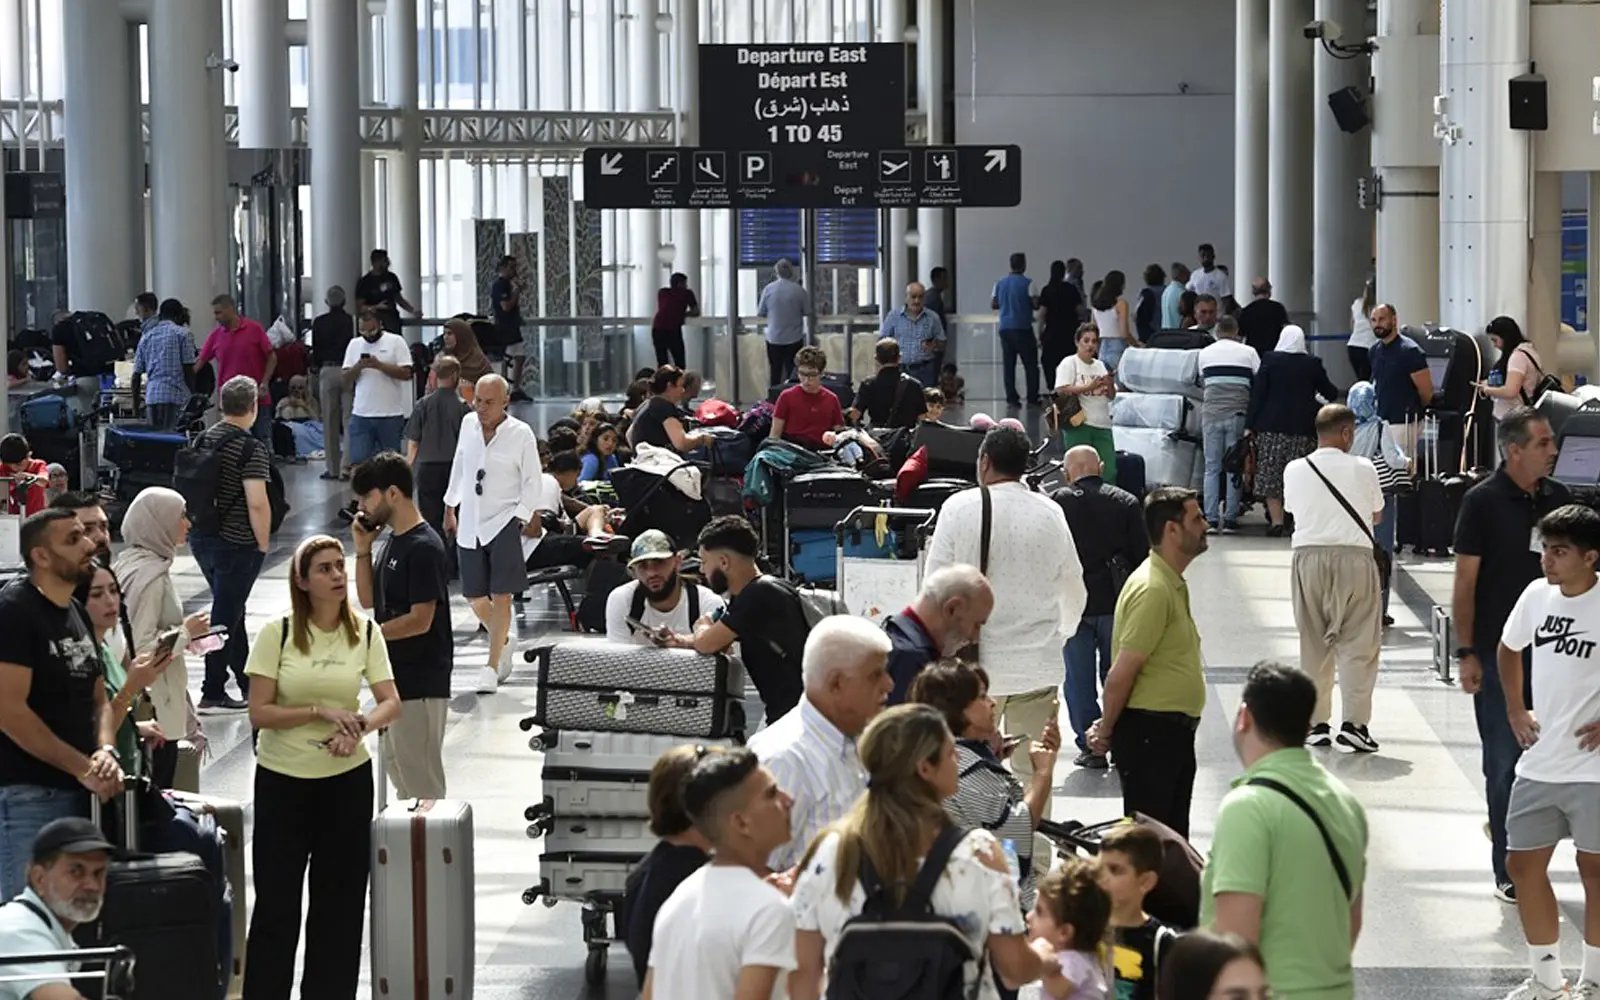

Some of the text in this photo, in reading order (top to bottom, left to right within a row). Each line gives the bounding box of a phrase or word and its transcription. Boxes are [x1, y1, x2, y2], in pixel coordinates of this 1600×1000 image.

[737, 47, 867, 67] Departure East
[758, 72, 848, 92] Départ Est
[809, 95, 850, 116] ذهاب
[767, 125, 843, 143] 1 TO 45
[827, 150, 870, 160] Departure
[838, 160, 858, 170] East
[747, 156, 765, 179] P
[841, 196, 856, 205] Est
[1540, 614, 1576, 635] JUST
